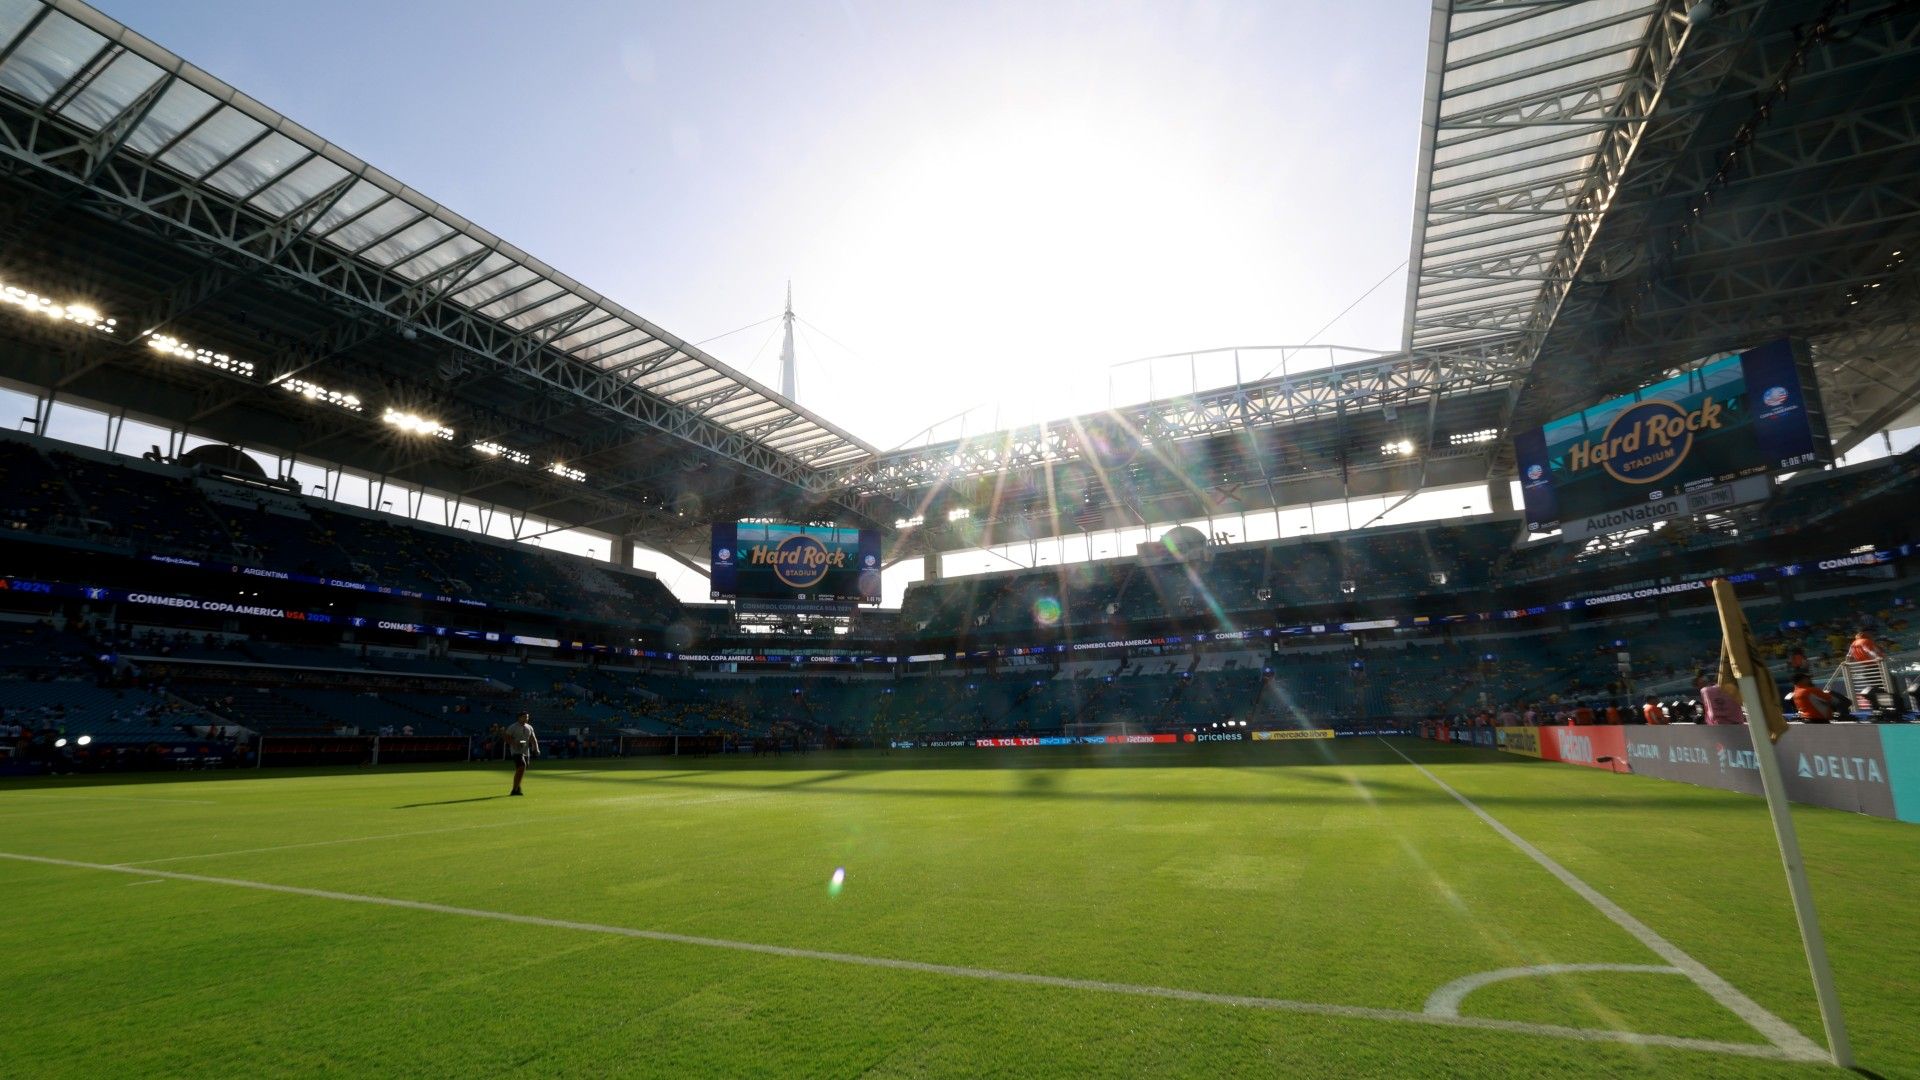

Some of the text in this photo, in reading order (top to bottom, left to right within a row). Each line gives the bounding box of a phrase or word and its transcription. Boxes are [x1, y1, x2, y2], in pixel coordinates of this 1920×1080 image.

[1568, 396, 1723, 472] Hard Rock
[1623, 448, 1675, 472] STADIUM
[1801, 452, 1816, 462] PM
[1586, 500, 1679, 532] AutoNation
[752, 544, 846, 568] Hard Rock
[243, 567, 289, 580] ARGENTINA
[785, 569, 817, 577] STADIUM
[12, 580, 52, 593] 2024
[331, 579, 366, 591] COLOMBIA
[1584, 592, 1633, 606] CONMEBOL
[1634, 587, 1661, 599] COPA
[1660, 580, 1706, 594] AMERICA
[127, 593, 331, 623] CONMEBOL COPA AMERICA USA 2024
[796, 604, 824, 612] AMERICA
[1073, 641, 1107, 650] CONMEBOL
[1107, 640, 1124, 648] COPA
[1124, 639, 1152, 647] AMERICA
[678, 654, 710, 662] CONMEBOL
[1198, 732, 1243, 742] priceless
[1273, 731, 1309, 739] mercado
[977, 739, 995, 747] TCL
[998, 738, 1017, 746] TCL
[1020, 738, 1040, 746] TCL
[1632, 743, 1659, 759] LATAM
[1676, 746, 1709, 764] DELTA
[1815, 754, 1885, 783] DELTA
